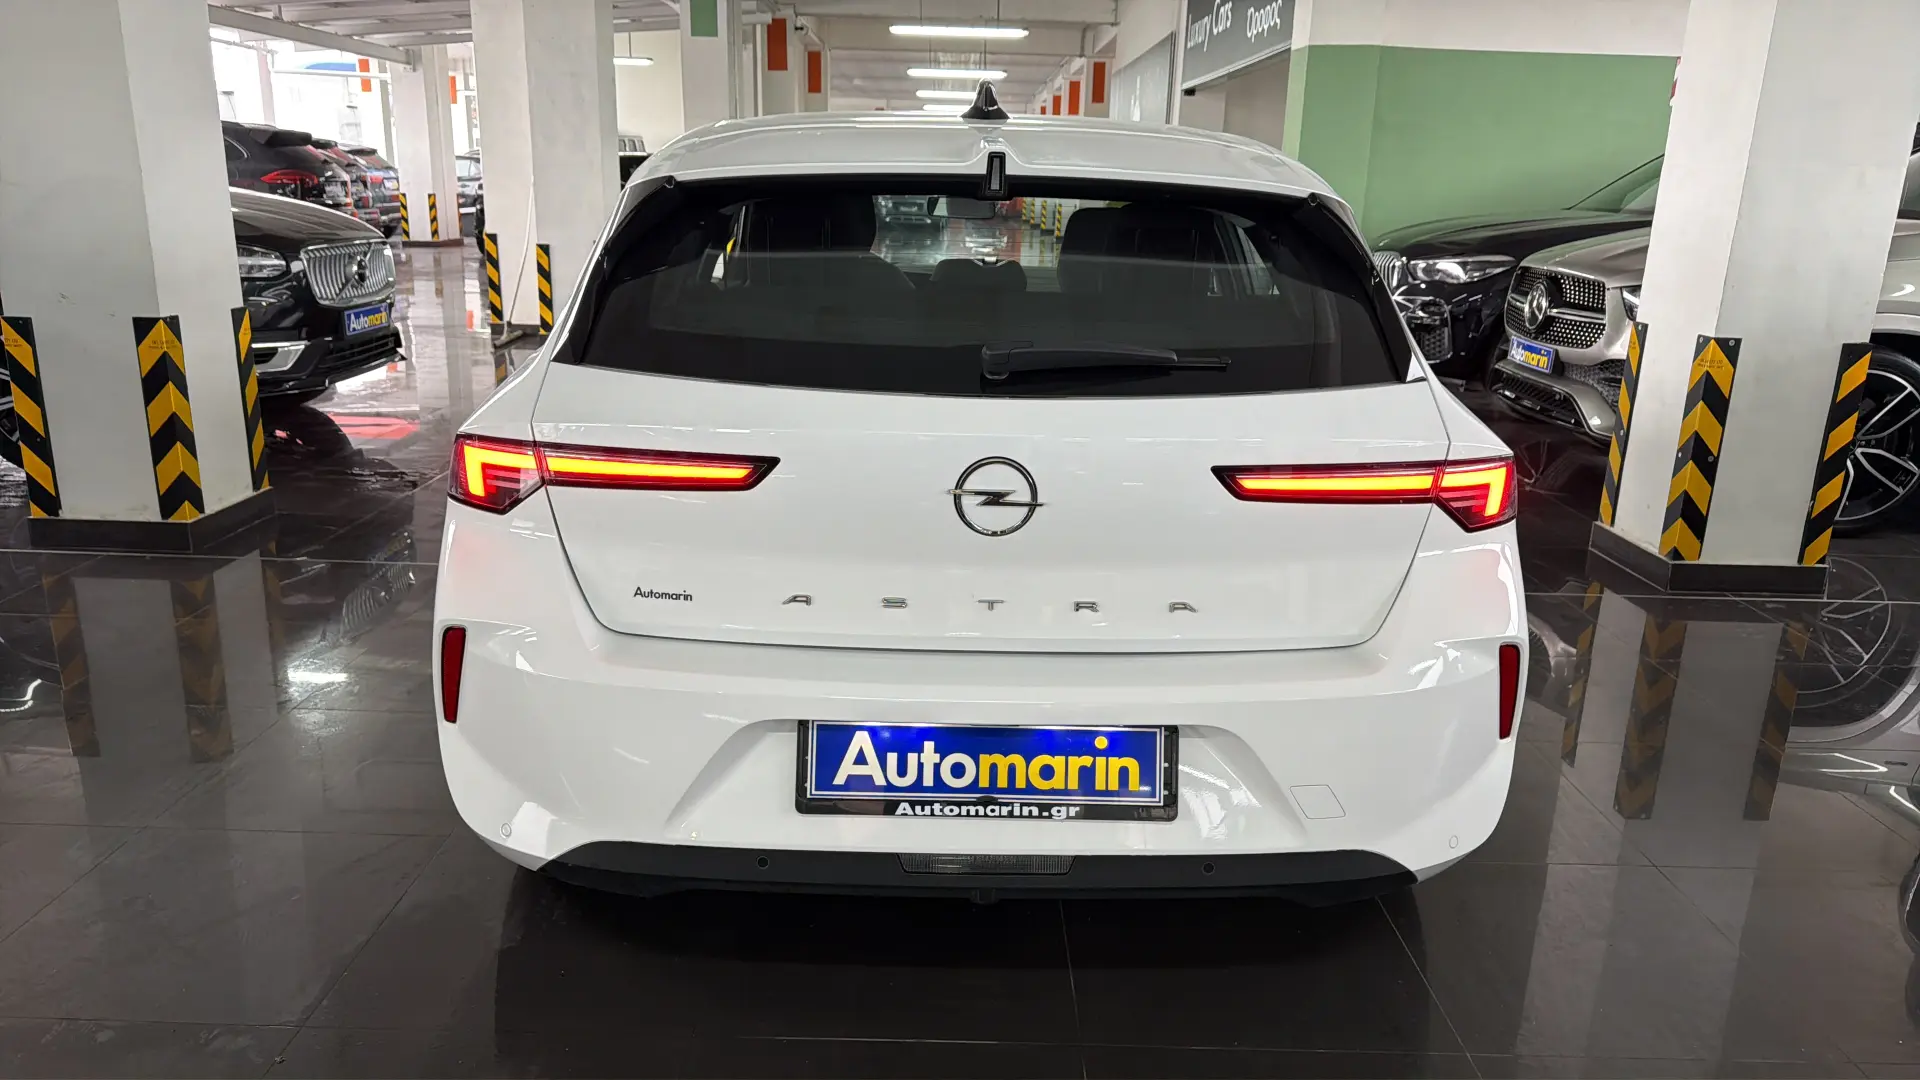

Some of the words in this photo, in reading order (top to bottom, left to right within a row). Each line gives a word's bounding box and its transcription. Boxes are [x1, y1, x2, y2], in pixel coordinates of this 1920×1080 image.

[1187, 14, 1212, 52] Luxury
[1212, 0, 1232, 35] Cars
[1510, 340, 1548, 369] Automarin
[633, 586, 693, 602] Automarin
[782, 594, 1198, 613] ASTRA
[833, 730, 1140, 791] Automarin
[895, 802, 1081, 820] Automarin.gr
